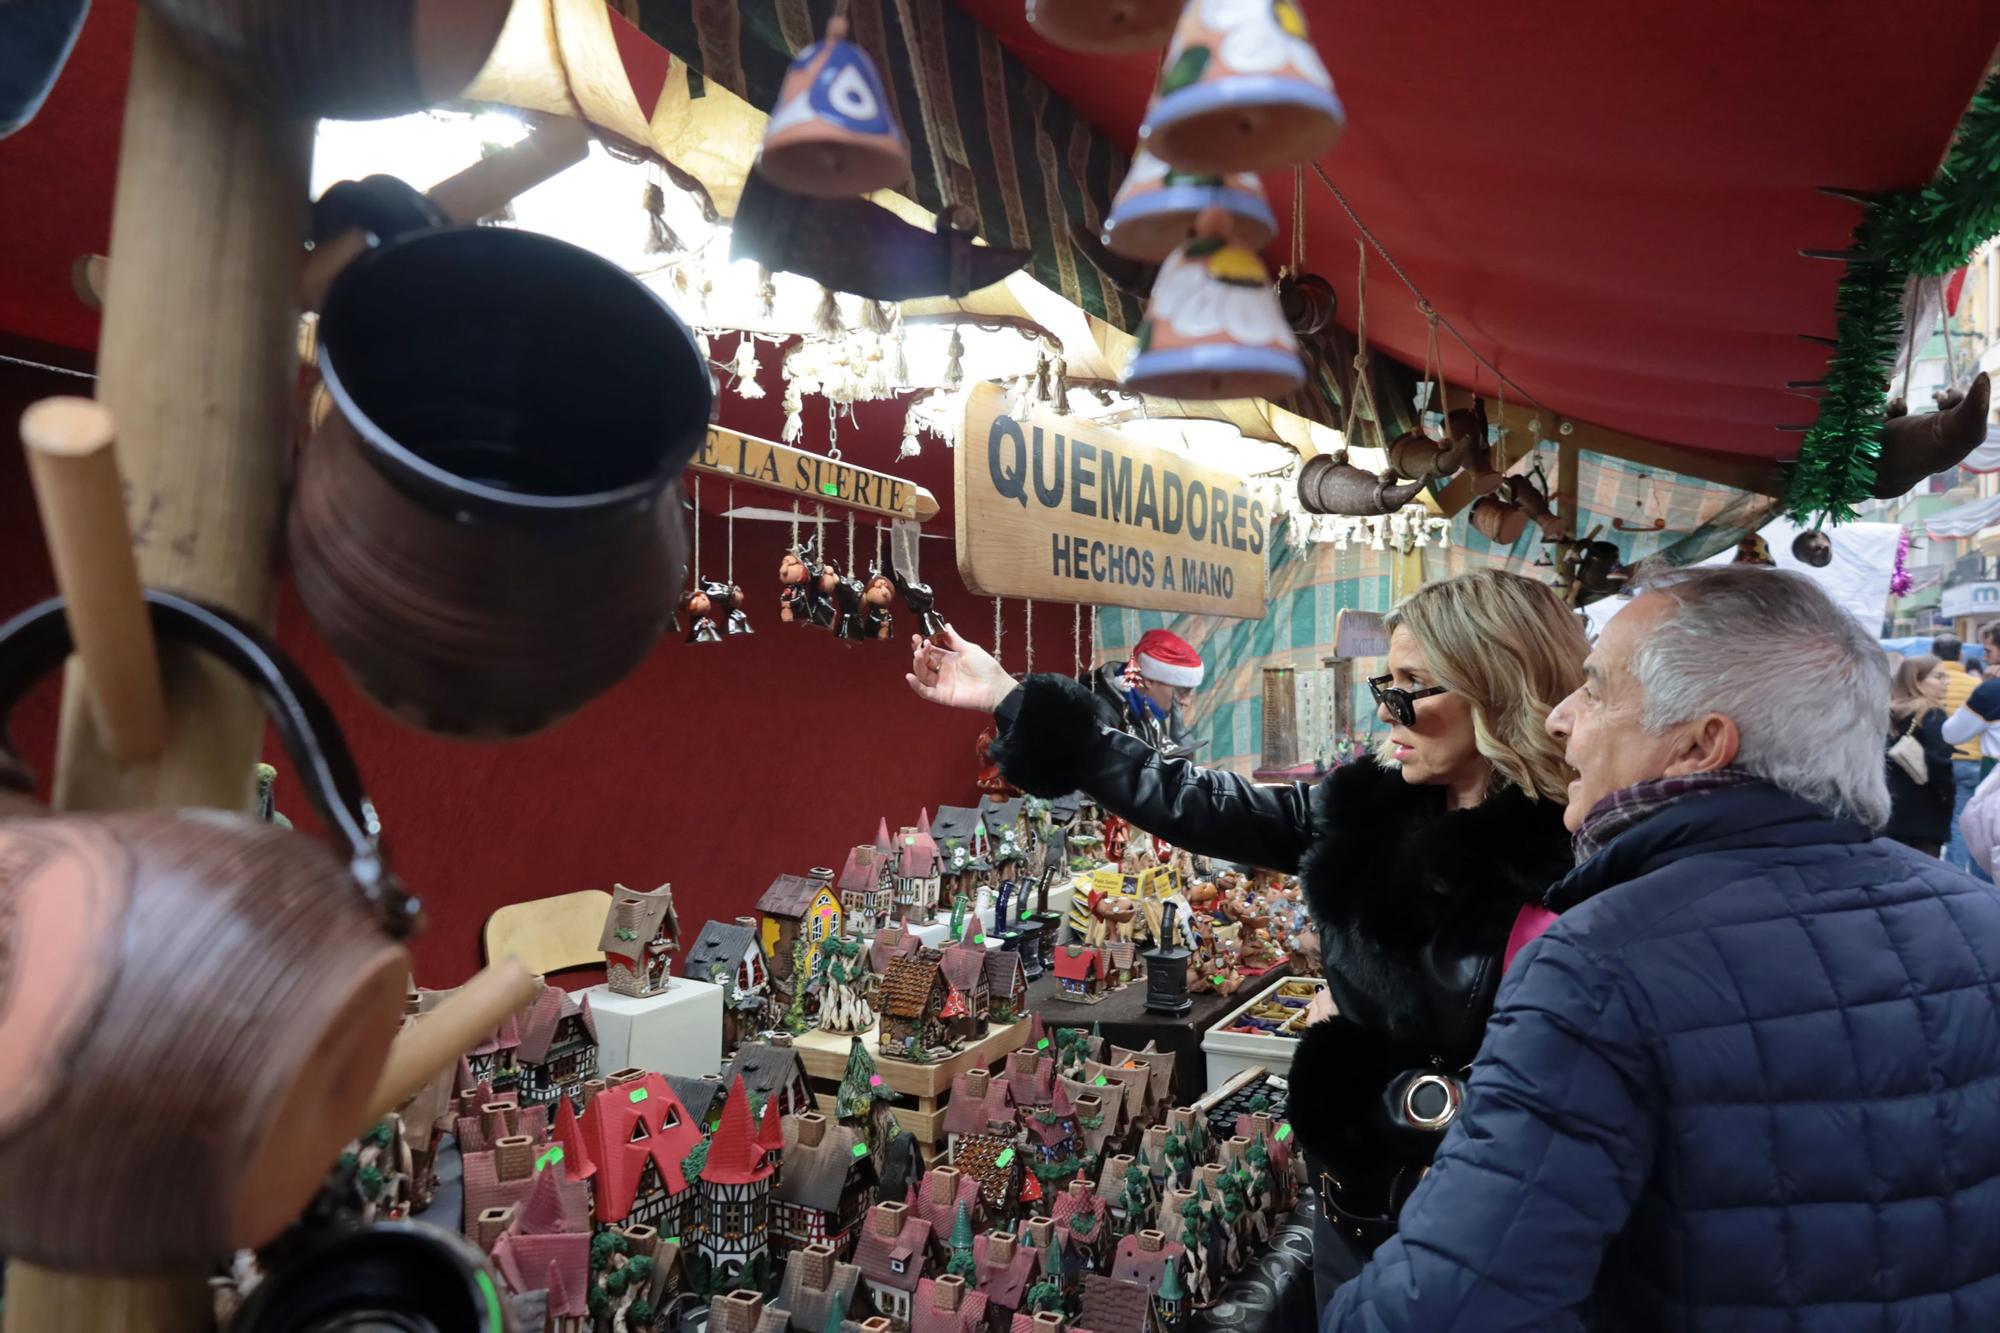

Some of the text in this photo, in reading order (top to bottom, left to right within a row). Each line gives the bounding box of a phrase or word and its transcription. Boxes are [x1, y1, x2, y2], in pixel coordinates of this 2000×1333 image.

[738, 438, 781, 482] LA
[795, 455, 904, 512] SUERTE
[988, 414, 1265, 555] QUEMADORES
[1052, 533, 1234, 600] HECHOS A MANO
